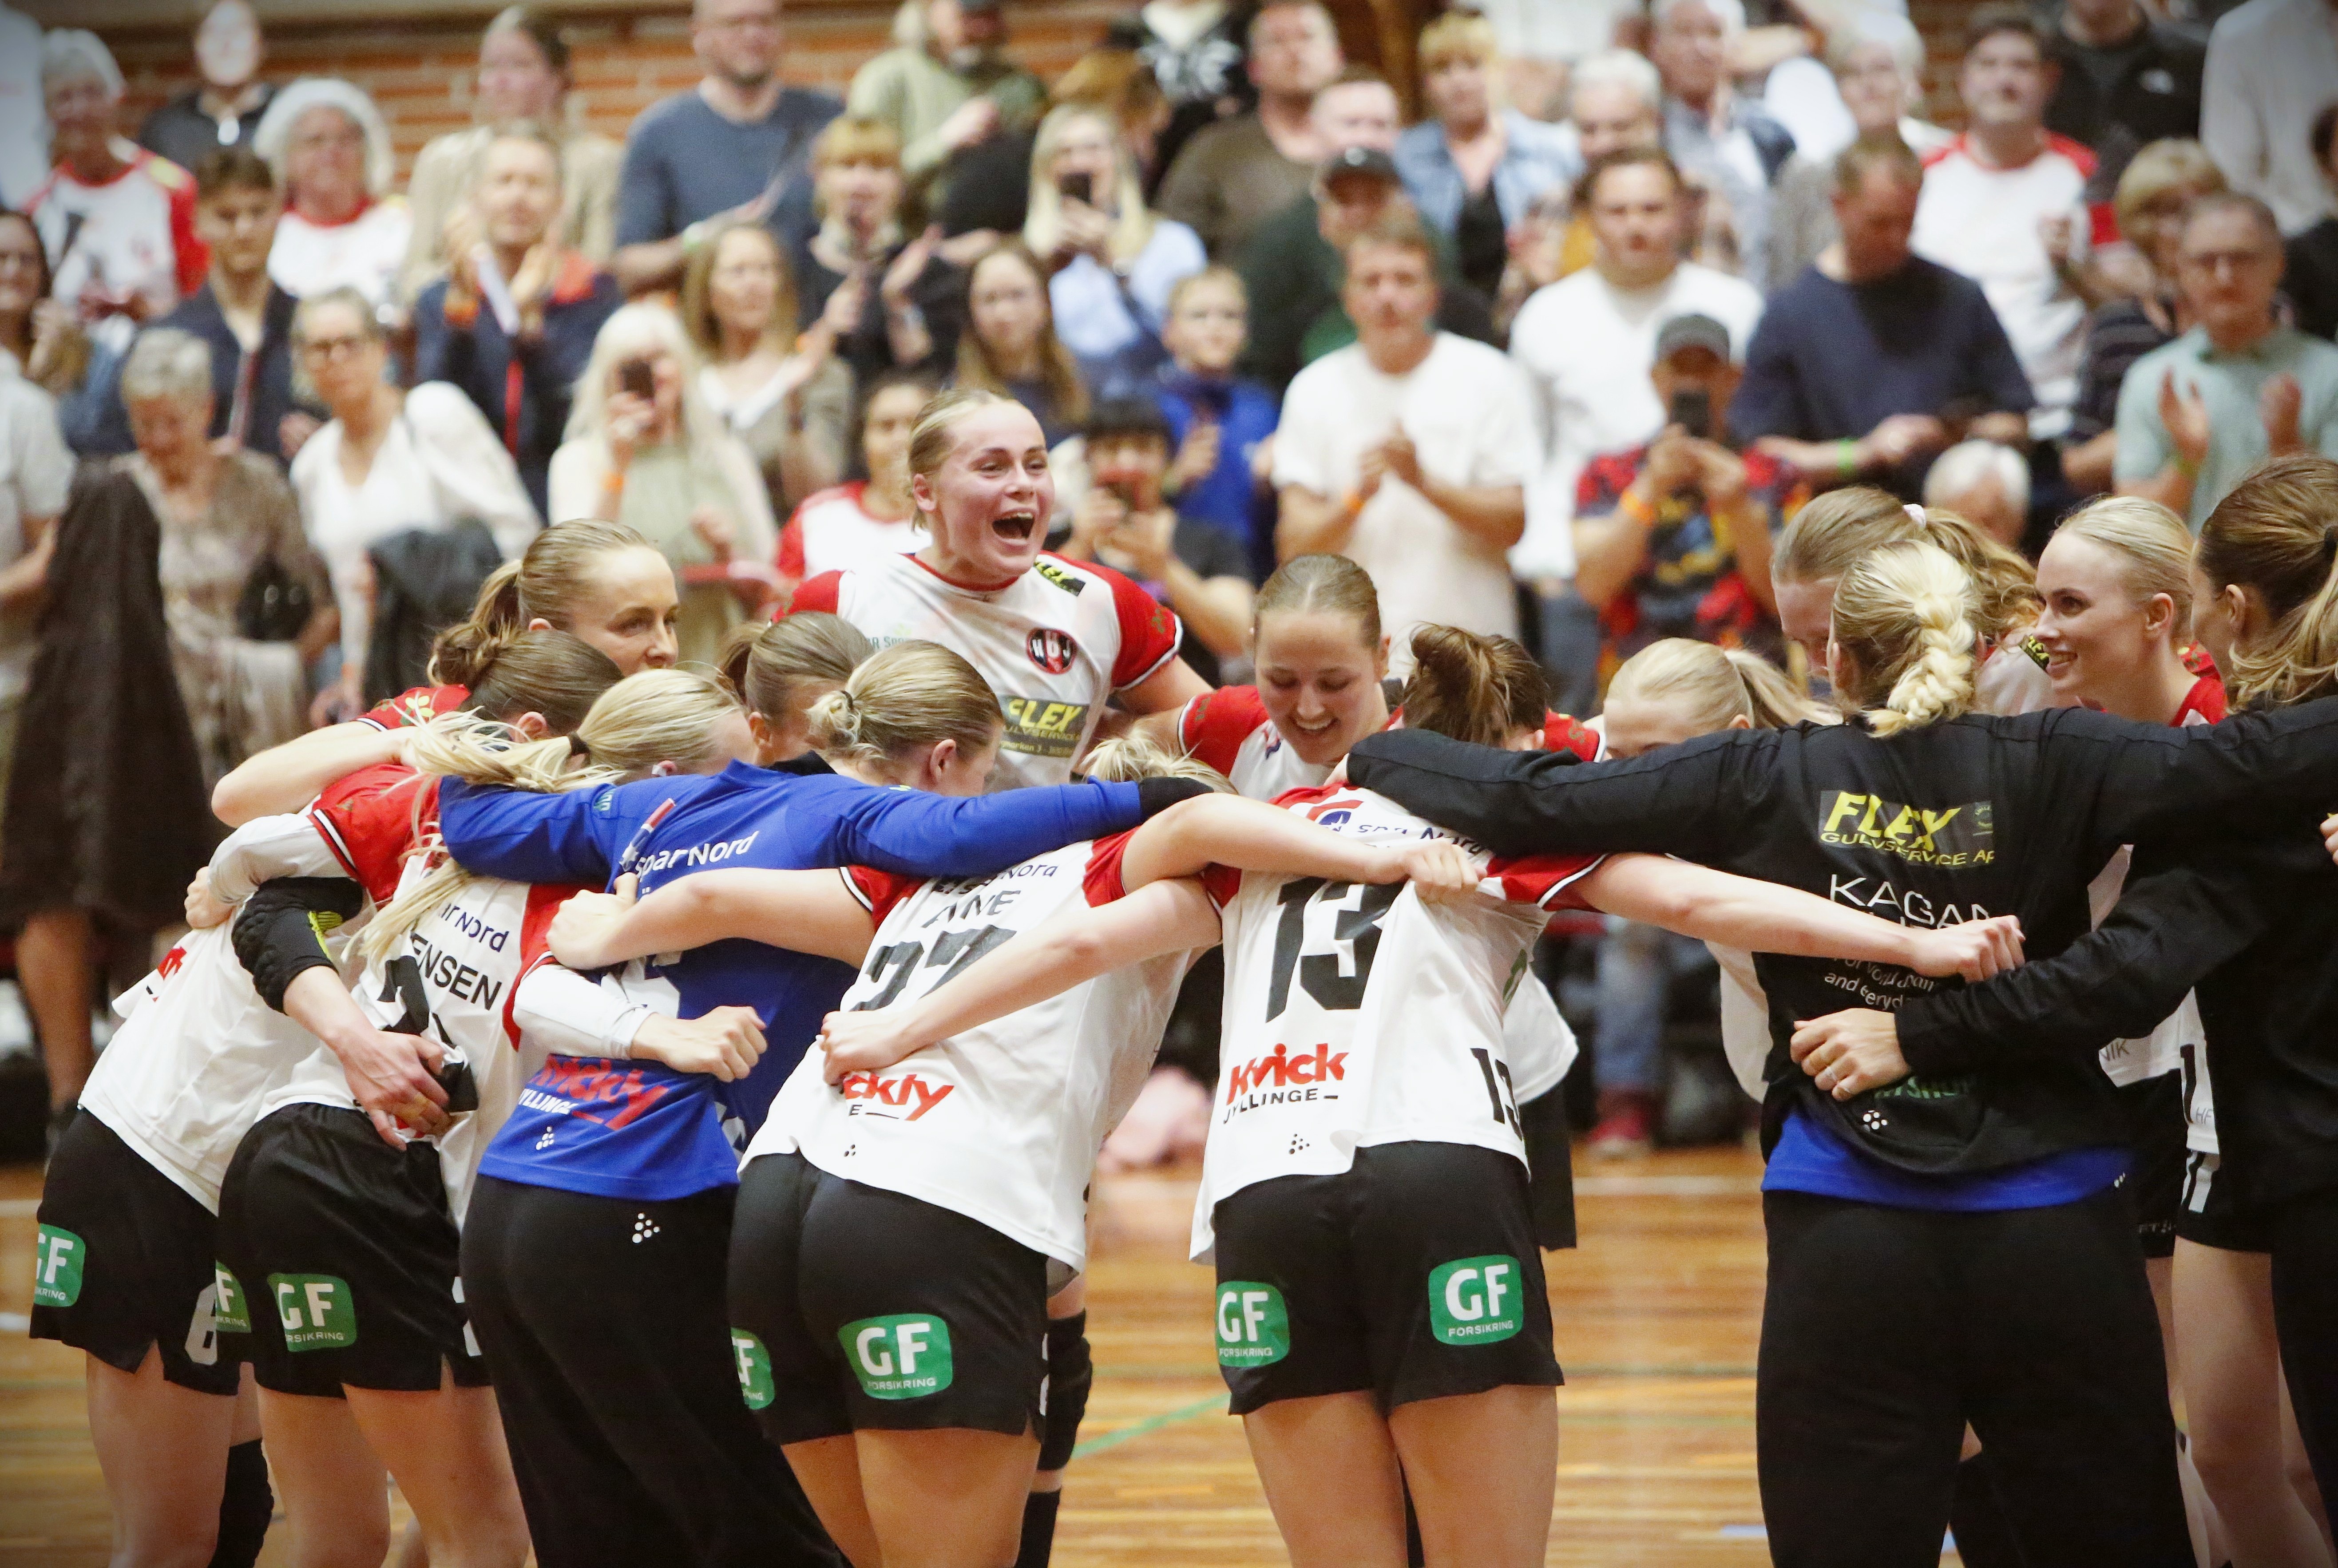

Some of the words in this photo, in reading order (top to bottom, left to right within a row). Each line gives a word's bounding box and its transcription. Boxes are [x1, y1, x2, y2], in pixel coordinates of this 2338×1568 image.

[1823, 792, 1962, 852] FLEX
[1265, 876, 1411, 1023] 13
[1824, 972, 1860, 991] and
[843, 1073, 955, 1121] ckly
[278, 1283, 334, 1330] GF
[1445, 1264, 1509, 1321] GF
[285, 1331, 345, 1343] RSIKRING
[1218, 1291, 1268, 1342] GF
[1448, 1320, 1514, 1337] FORSIKRING
[856, 1322, 930, 1376] GF
[1219, 1347, 1273, 1358] FORSIKRING
[867, 1377, 936, 1390] FORSIKRING
